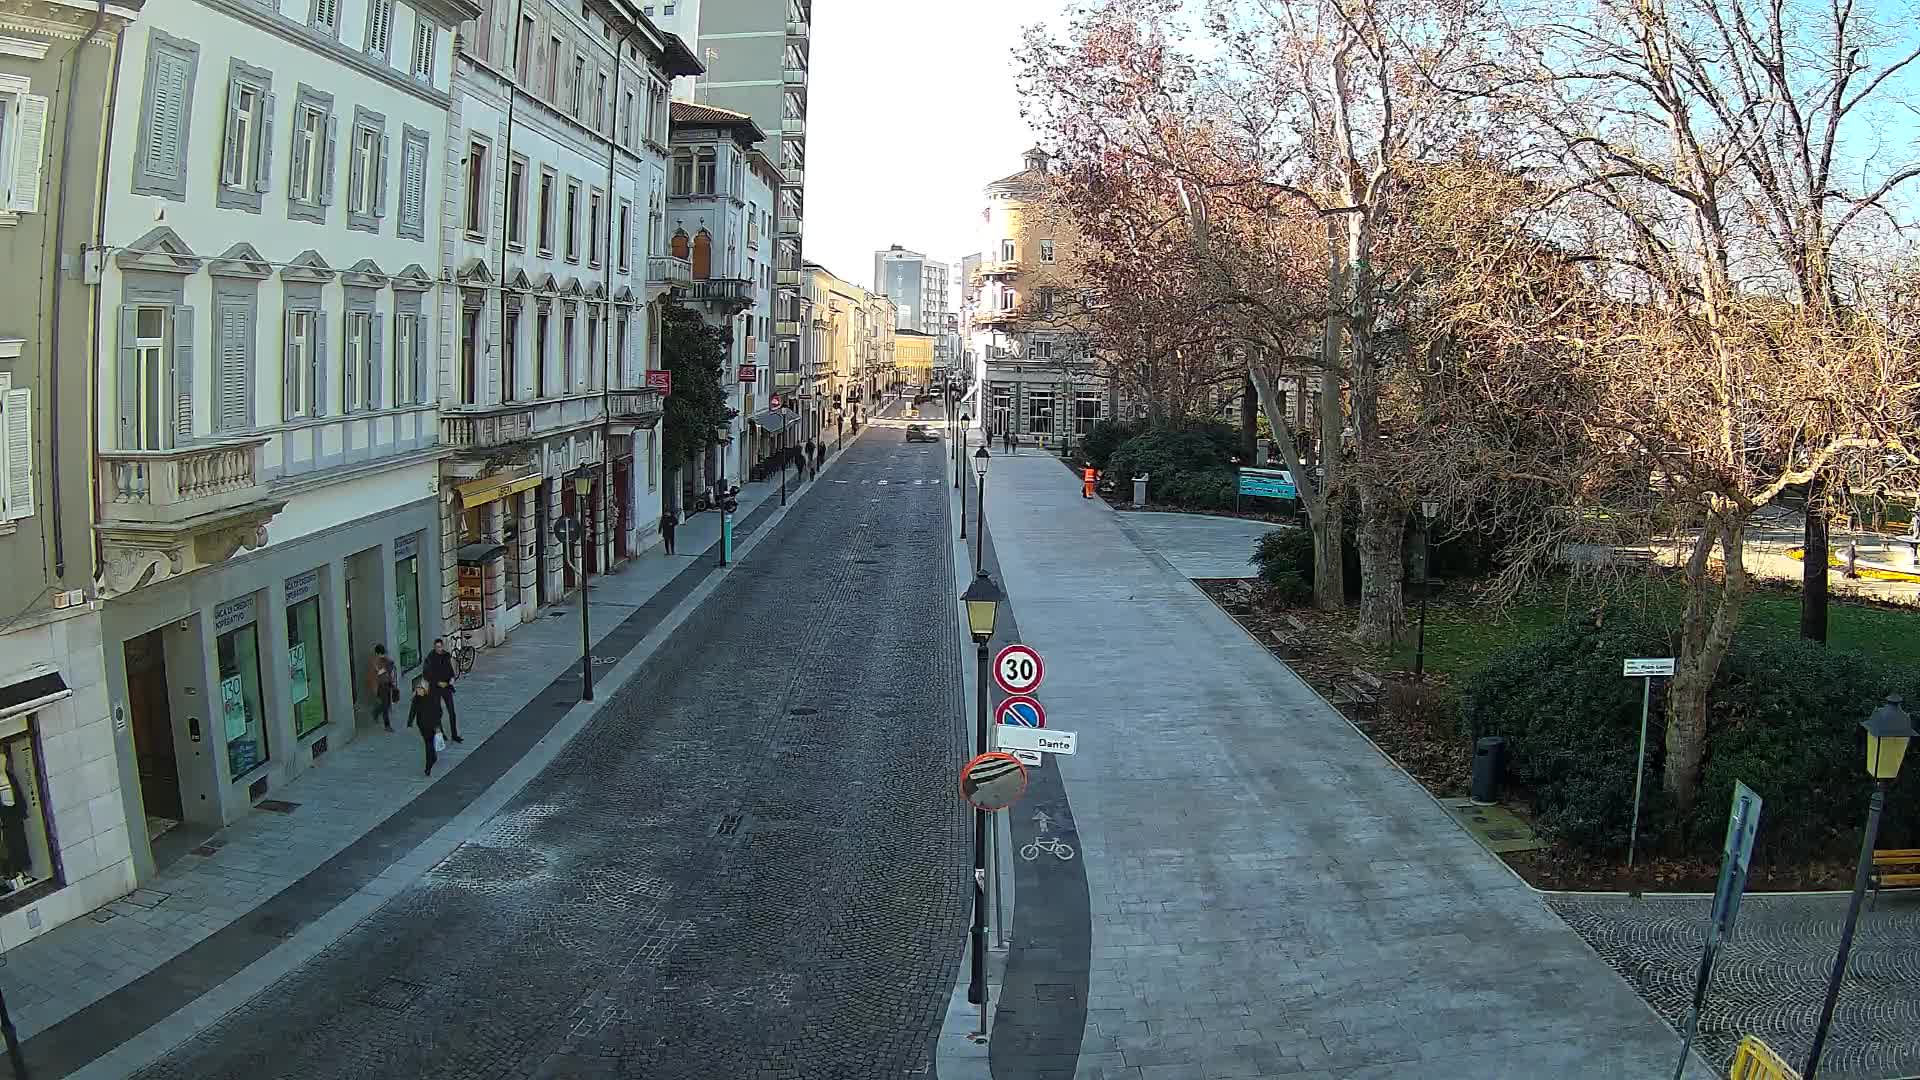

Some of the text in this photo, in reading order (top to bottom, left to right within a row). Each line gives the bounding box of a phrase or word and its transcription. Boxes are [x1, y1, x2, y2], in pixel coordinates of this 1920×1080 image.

[1006, 658, 1033, 681] 30
[223, 678, 240, 701] 130
[1039, 738, 1070, 750] Dante
